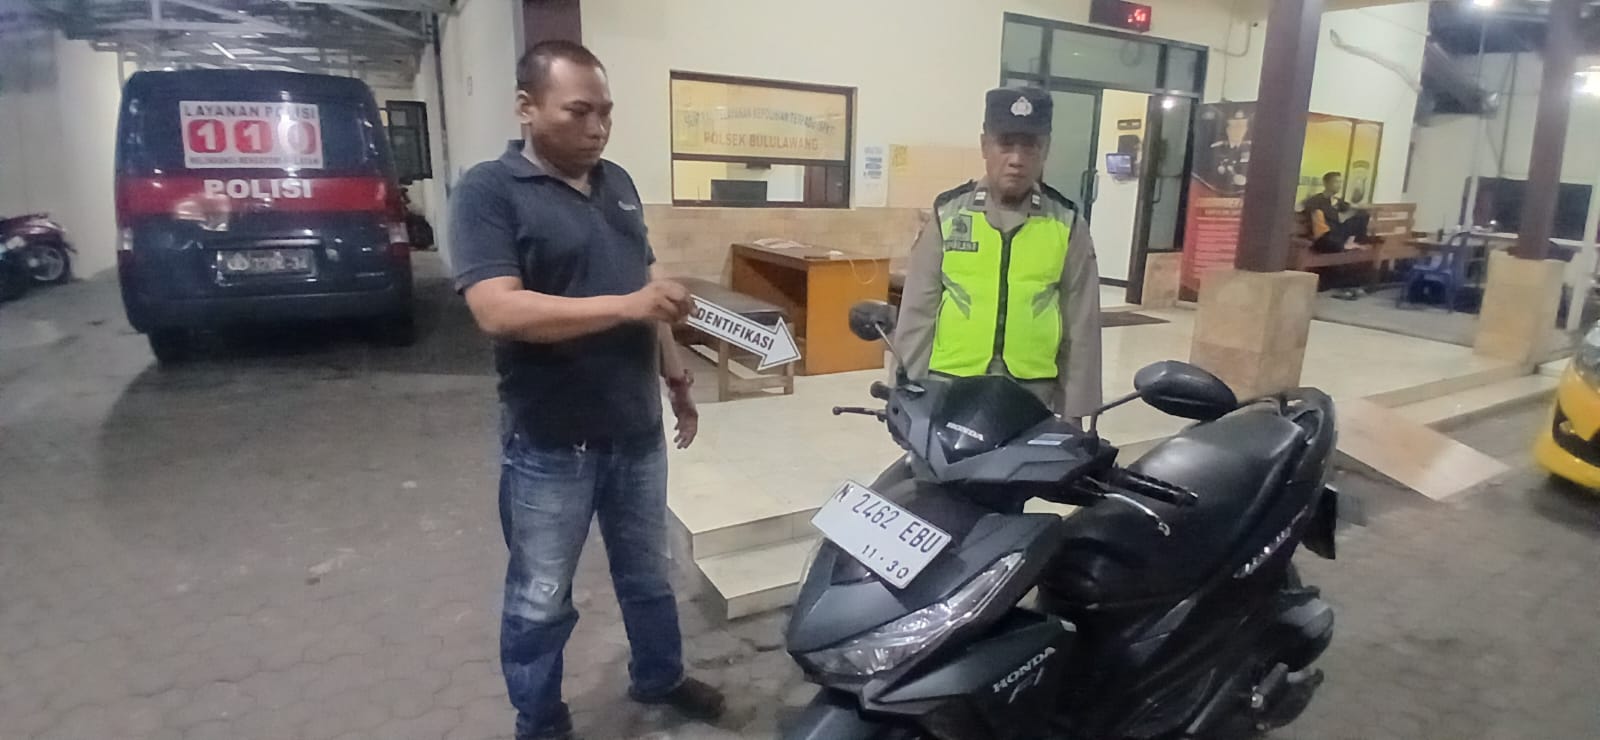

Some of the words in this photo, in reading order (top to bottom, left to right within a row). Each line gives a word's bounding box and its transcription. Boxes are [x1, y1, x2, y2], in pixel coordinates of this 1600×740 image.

[185, 105, 260, 117] LAYANAN
[265, 106, 317, 119] POISI
[703, 131, 746, 147] POLSEK
[749, 133, 819, 151] BULULAWANG
[204, 179, 312, 199] POLISI
[694, 307, 775, 351] DENTIFIKASI
[946, 421, 984, 441] HONDA
[834, 483, 854, 503] N
[852, 493, 900, 530] 2462
[899, 521, 942, 553] EBU
[992, 646, 1056, 693] HONDA
